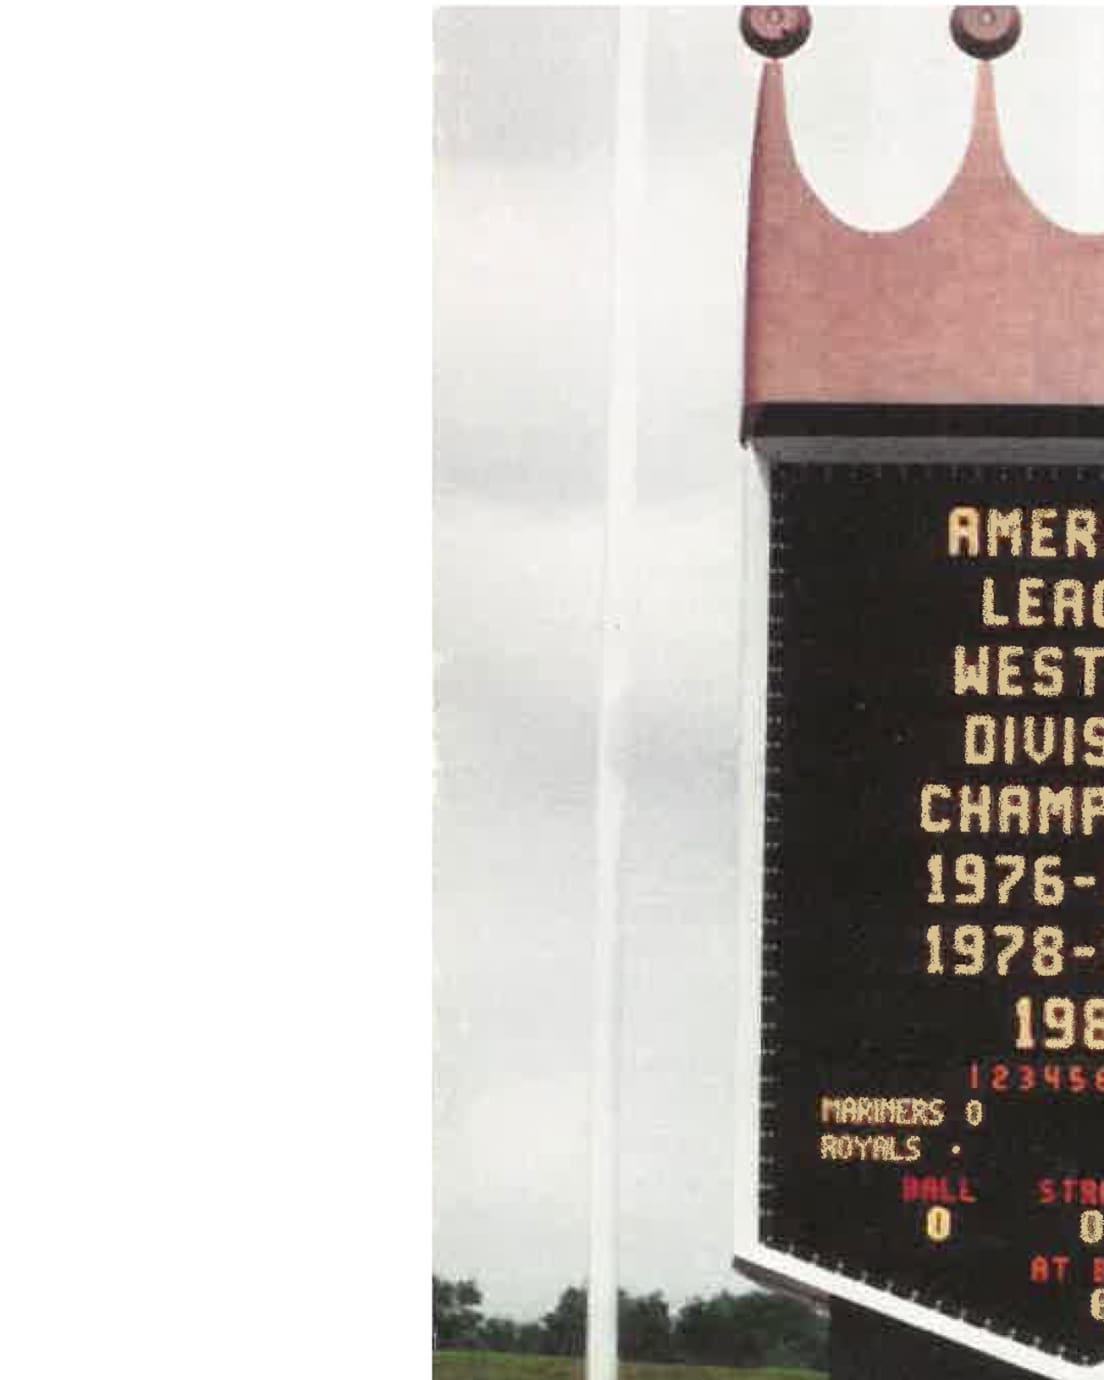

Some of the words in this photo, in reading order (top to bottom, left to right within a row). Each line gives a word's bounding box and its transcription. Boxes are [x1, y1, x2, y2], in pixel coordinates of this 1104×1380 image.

[819, 1095, 946, 1127] MARINERS
[964, 1099, 984, 1127] 0
[819, 1133, 921, 1162] ROYALS
[901, 1175, 976, 1203] BALL
[926, 1205, 952, 1242] 0
[1079, 1209, 1104, 1244] 0
[1030, 1254, 1071, 1283] AT
